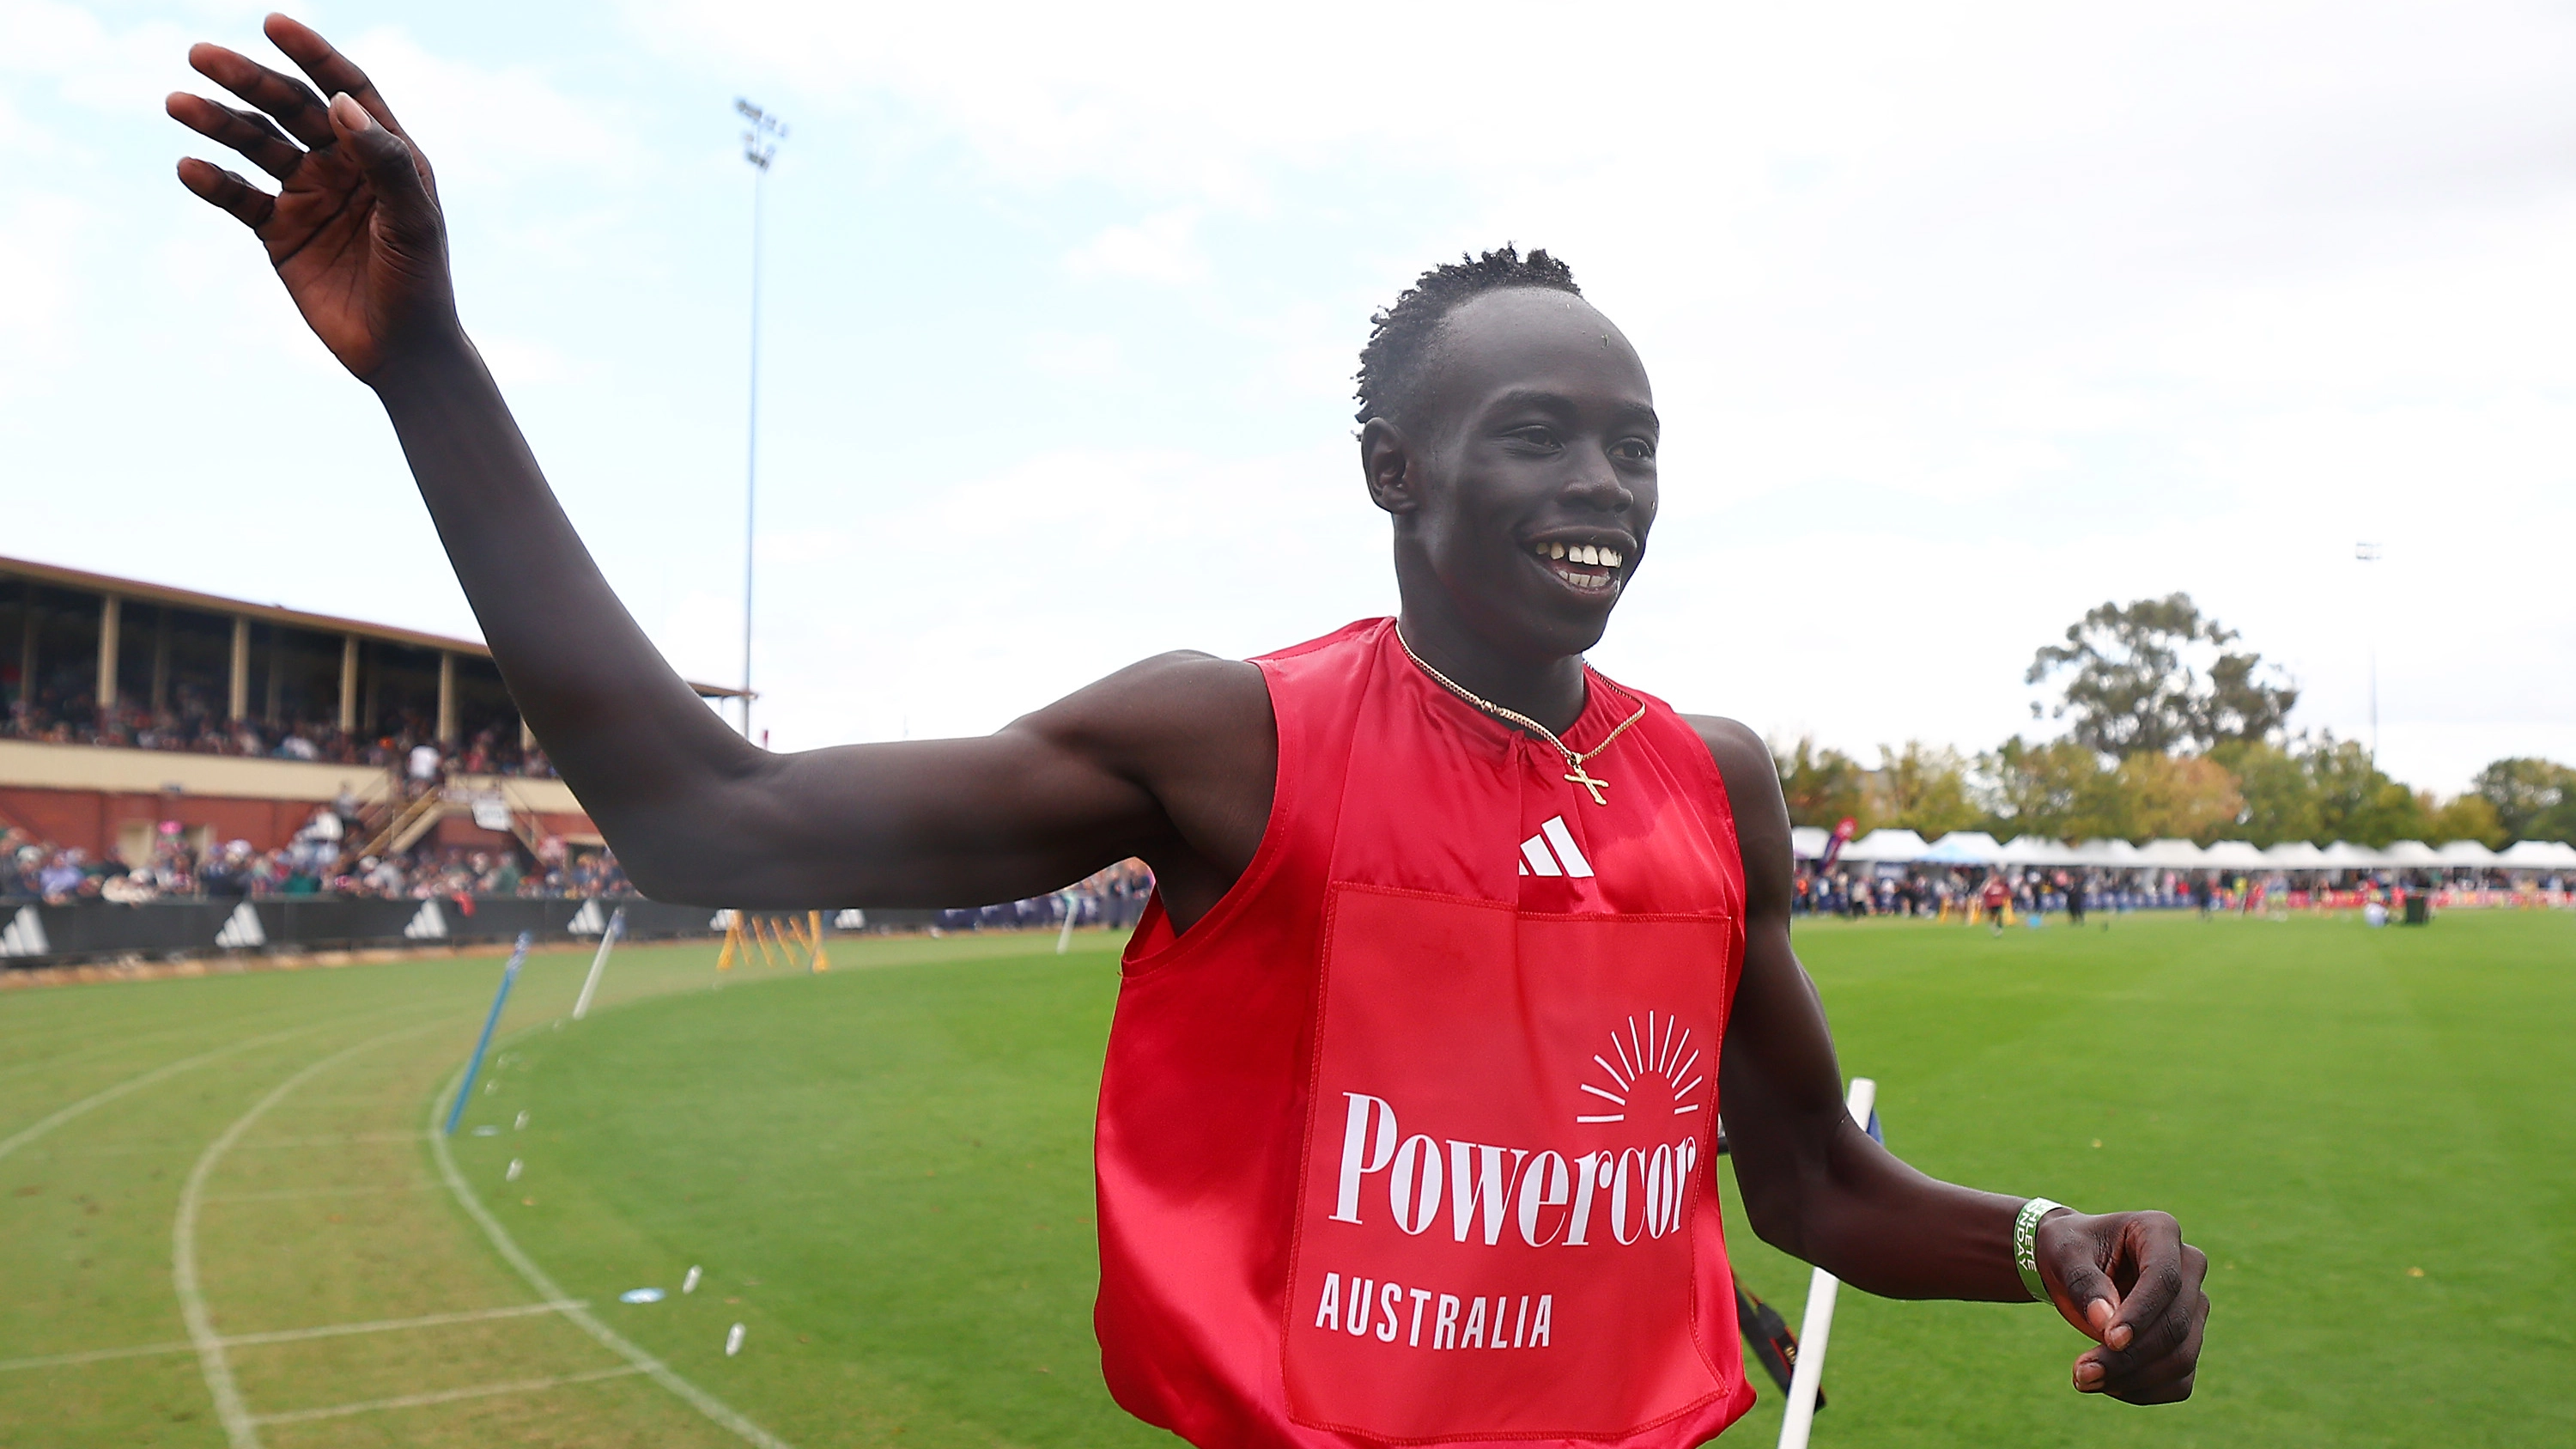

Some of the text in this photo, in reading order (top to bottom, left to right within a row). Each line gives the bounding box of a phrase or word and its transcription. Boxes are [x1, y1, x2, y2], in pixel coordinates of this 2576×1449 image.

[1327, 1091, 1698, 1248] Powercor
[2016, 1198, 2042, 1271] ONDAY
[2024, 1200, 2052, 1272] THLETE
[1315, 1272, 1553, 1350] AUSTRALIA
